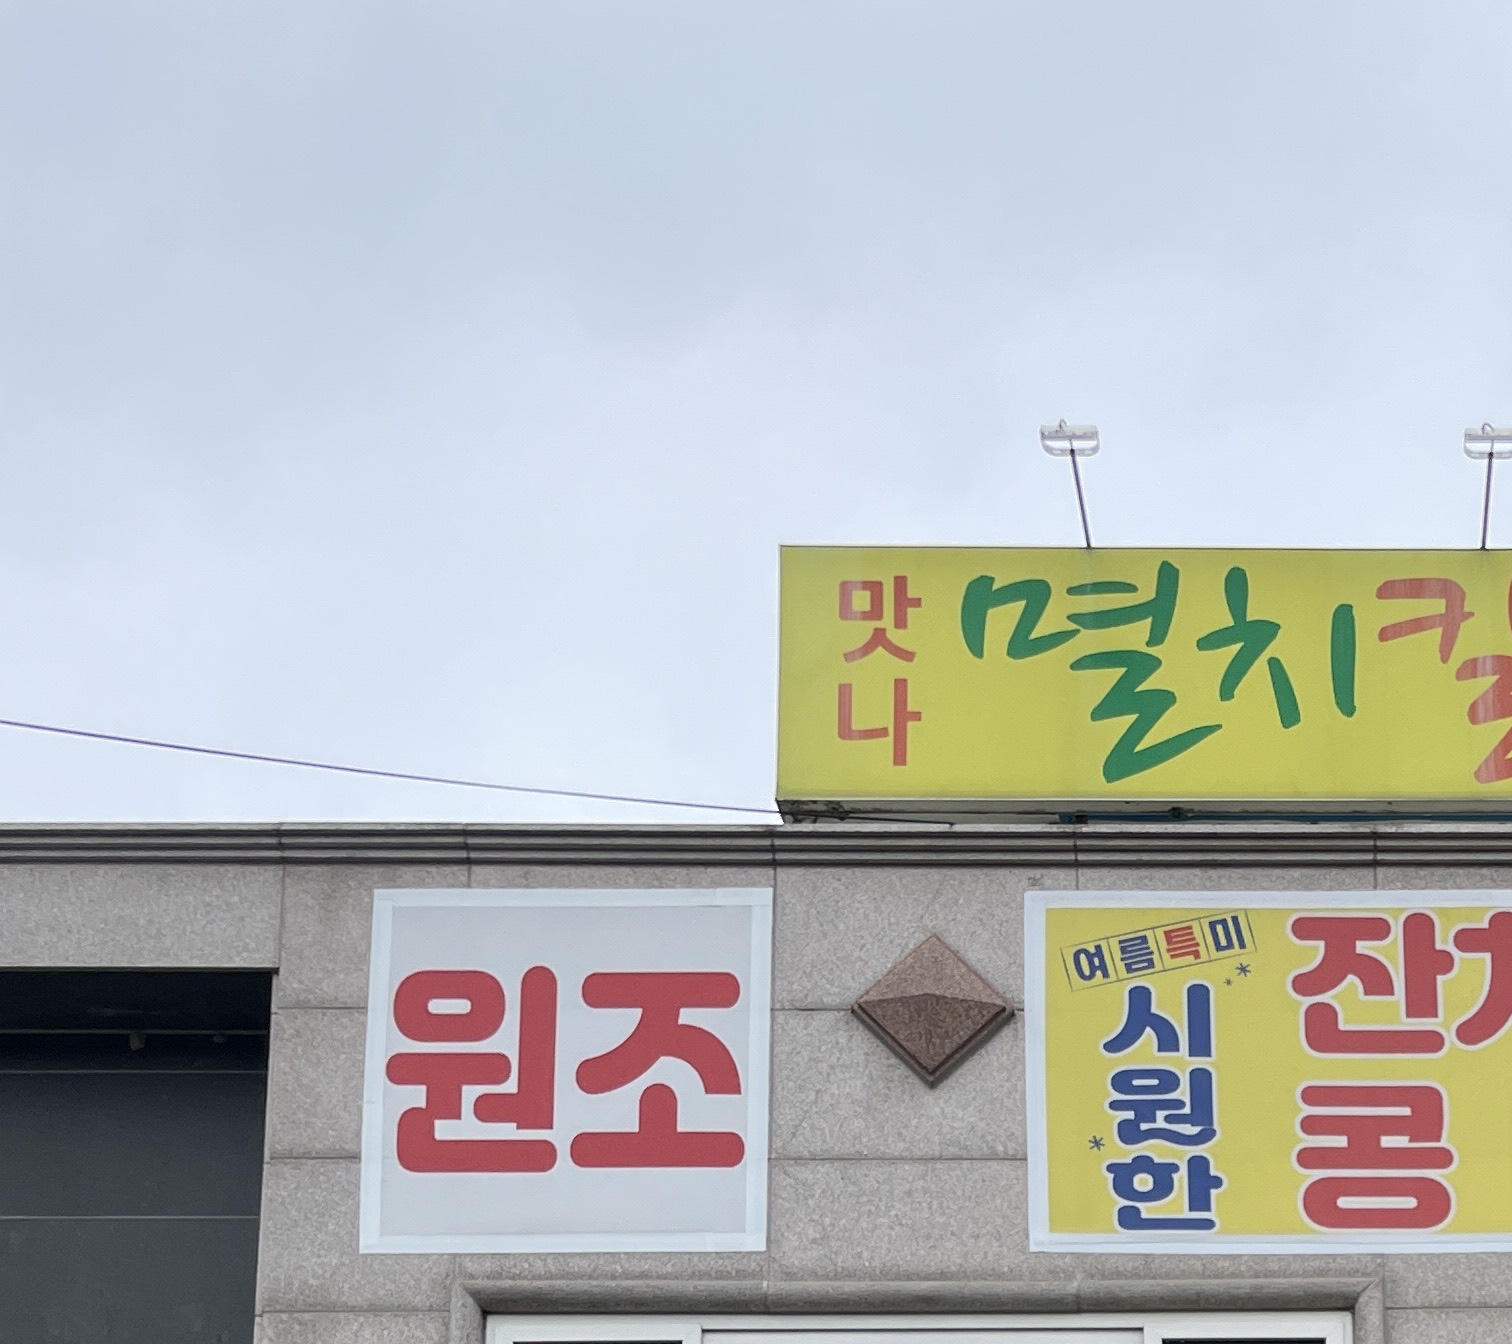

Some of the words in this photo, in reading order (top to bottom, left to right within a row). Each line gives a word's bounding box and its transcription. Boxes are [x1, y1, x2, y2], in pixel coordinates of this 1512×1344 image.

[838, 574, 922, 766] 맛나
[1073, 914, 1247, 982] 여름특미
[386, 965, 745, 1173] 원조
[1102, 983, 1223, 1231] 시원한
